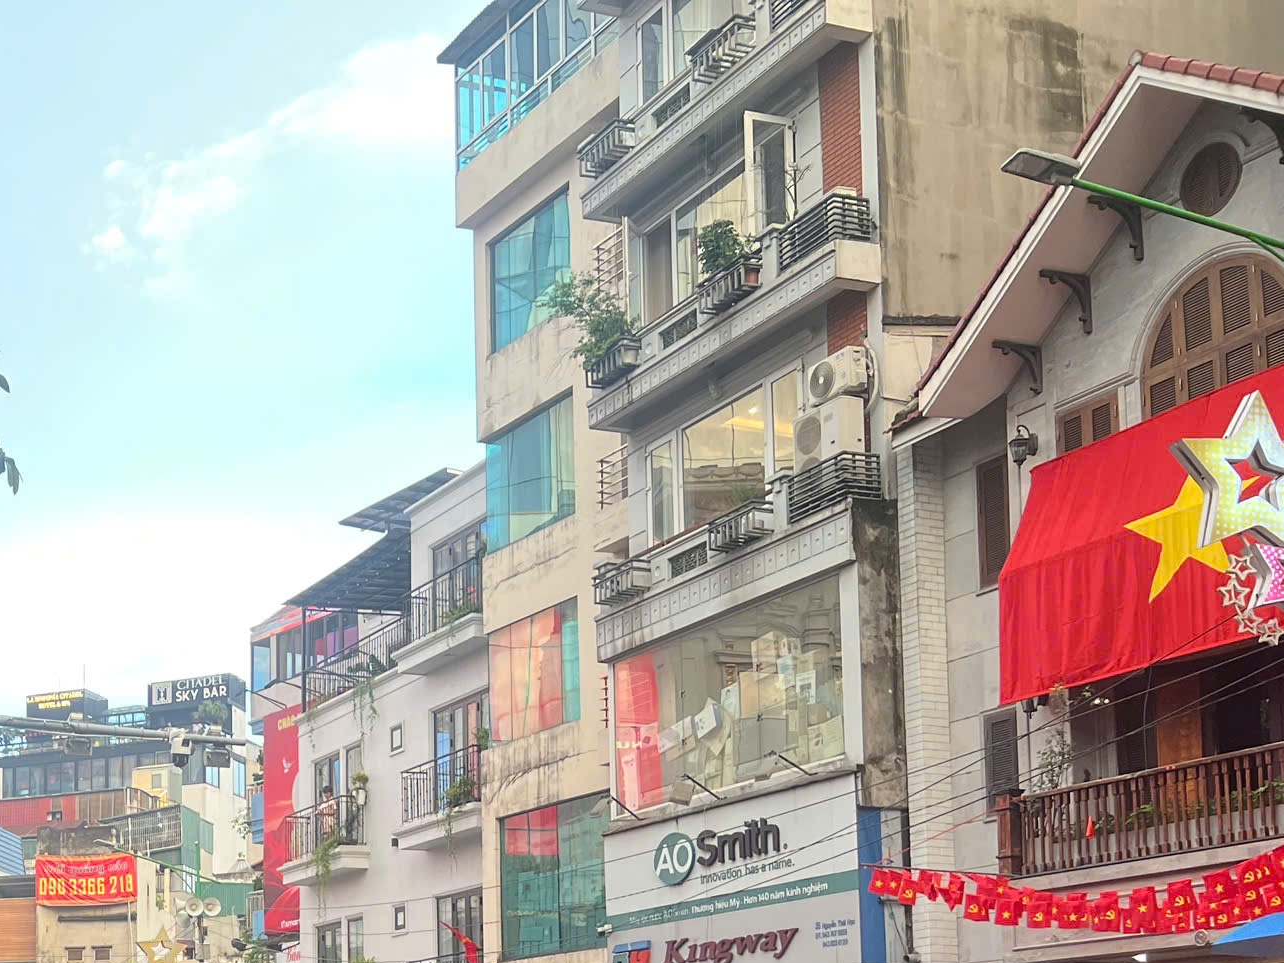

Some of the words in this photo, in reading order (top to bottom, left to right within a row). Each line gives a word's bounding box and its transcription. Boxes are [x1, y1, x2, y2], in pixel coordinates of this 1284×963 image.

[177, 675, 226, 690] CITADEL
[176, 689, 199, 702] SKY
[203, 685, 227, 699] BAR
[697, 817, 780, 867] Smith
[701, 867, 742, 884] Innovation
[745, 863, 759, 875] has
[691, 904, 714, 914] Thương
[757, 893, 770, 902] 140
[785, 885, 802, 897] kinh
